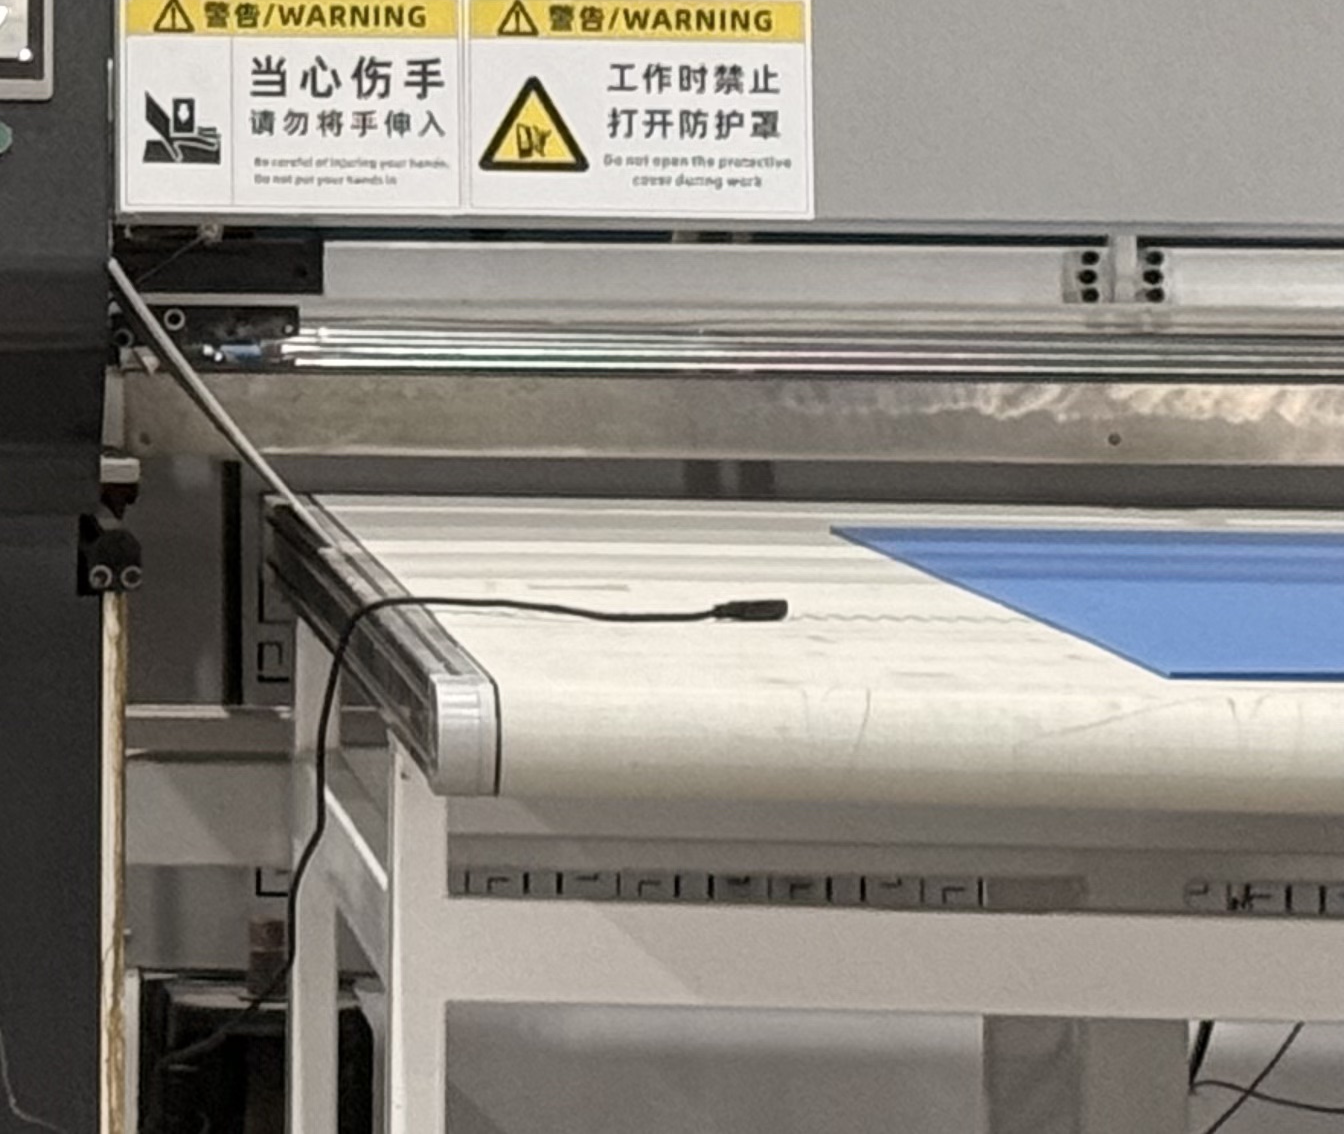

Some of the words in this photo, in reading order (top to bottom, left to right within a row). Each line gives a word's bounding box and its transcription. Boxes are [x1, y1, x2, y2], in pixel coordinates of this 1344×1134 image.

[204, 1, 427, 28] 警告/WARNING
[549, 5, 773, 32] 警告/WARNING
[250, 54, 445, 100] 当心伤手
[607, 63, 780, 95] 工作时禁止
[250, 109, 446, 138] 请勿将手伸入
[607, 107, 781, 140] 打开防护罩
[603, 153, 622, 167] Do
[625, 154, 649, 167] not
[652, 156, 688, 170] open
[691, 154, 715, 168] the
